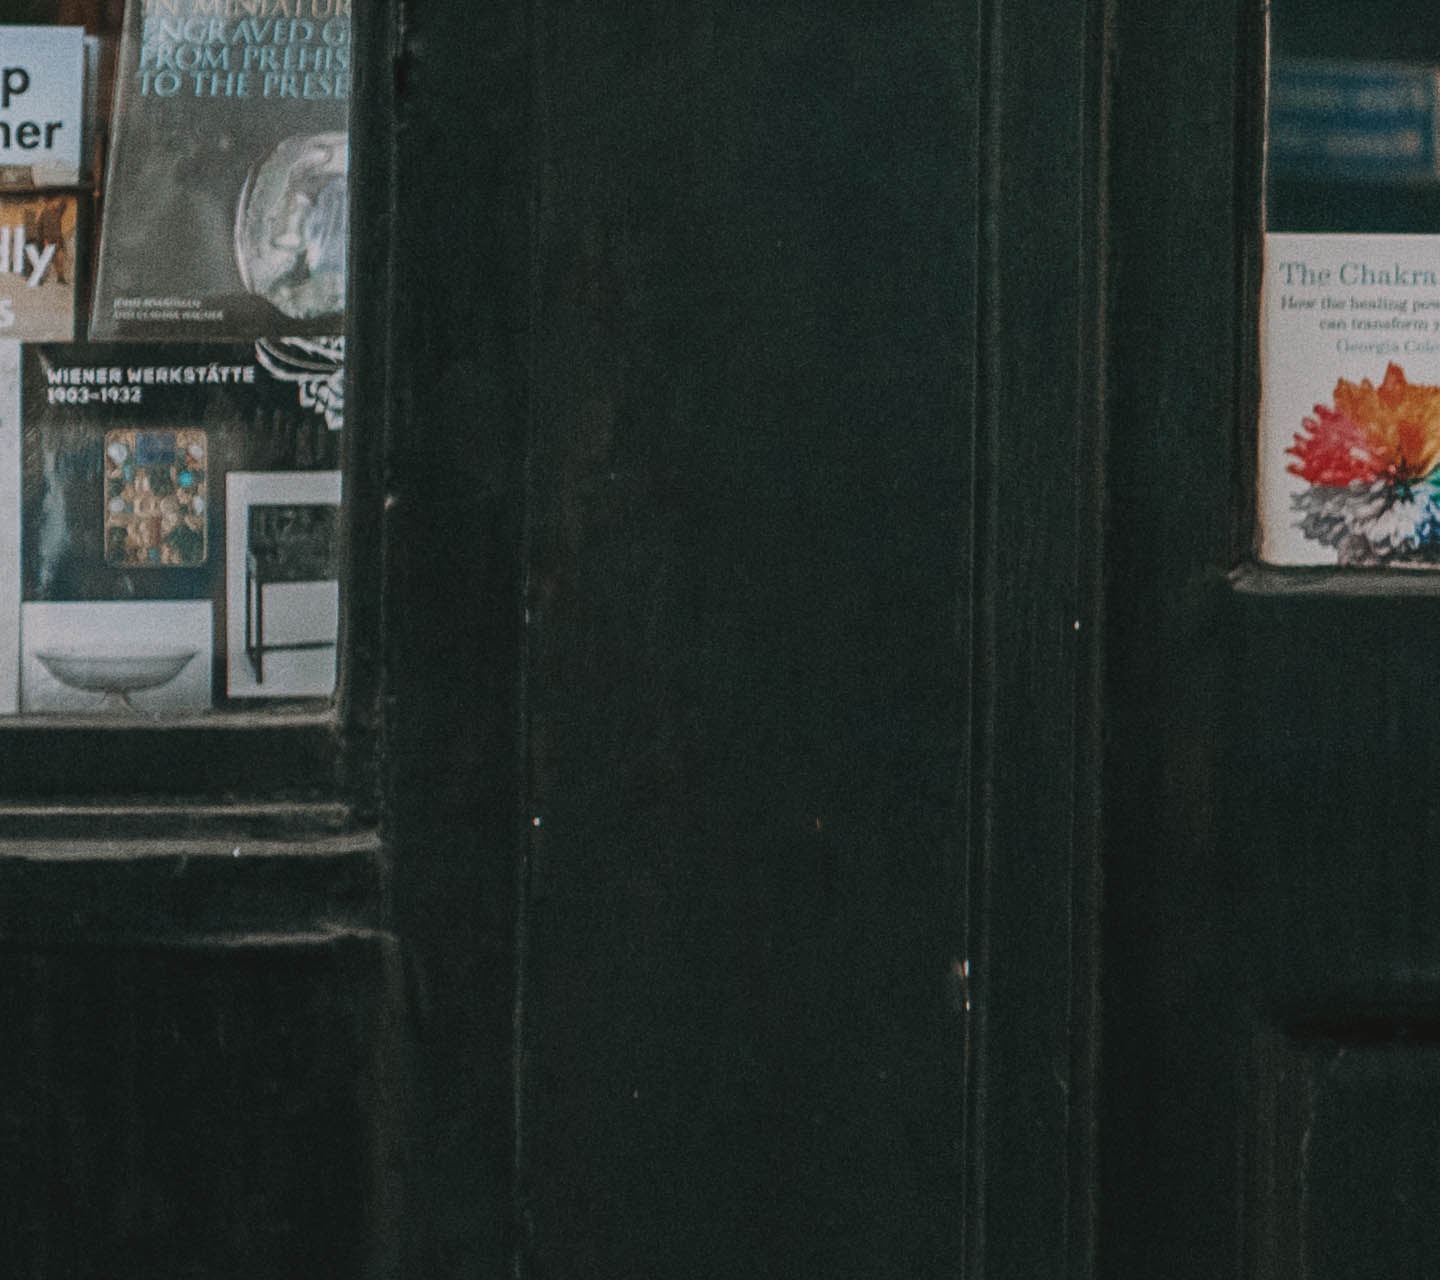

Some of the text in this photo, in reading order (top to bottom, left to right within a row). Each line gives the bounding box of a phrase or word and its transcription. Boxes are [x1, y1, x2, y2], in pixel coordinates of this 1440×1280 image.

[144, 20, 313, 47] ENGRAVED
[140, 45, 230, 72] FROM
[140, 70, 182, 98] TO
[194, 70, 252, 99] THE
[1279, 261, 1332, 288] The
[1338, 262, 1437, 288] Chakra
[1280, 294, 1316, 310] How
[1350, 295, 1408, 314] healing
[46, 363, 255, 384] WIENER WERKSTÄTTE
